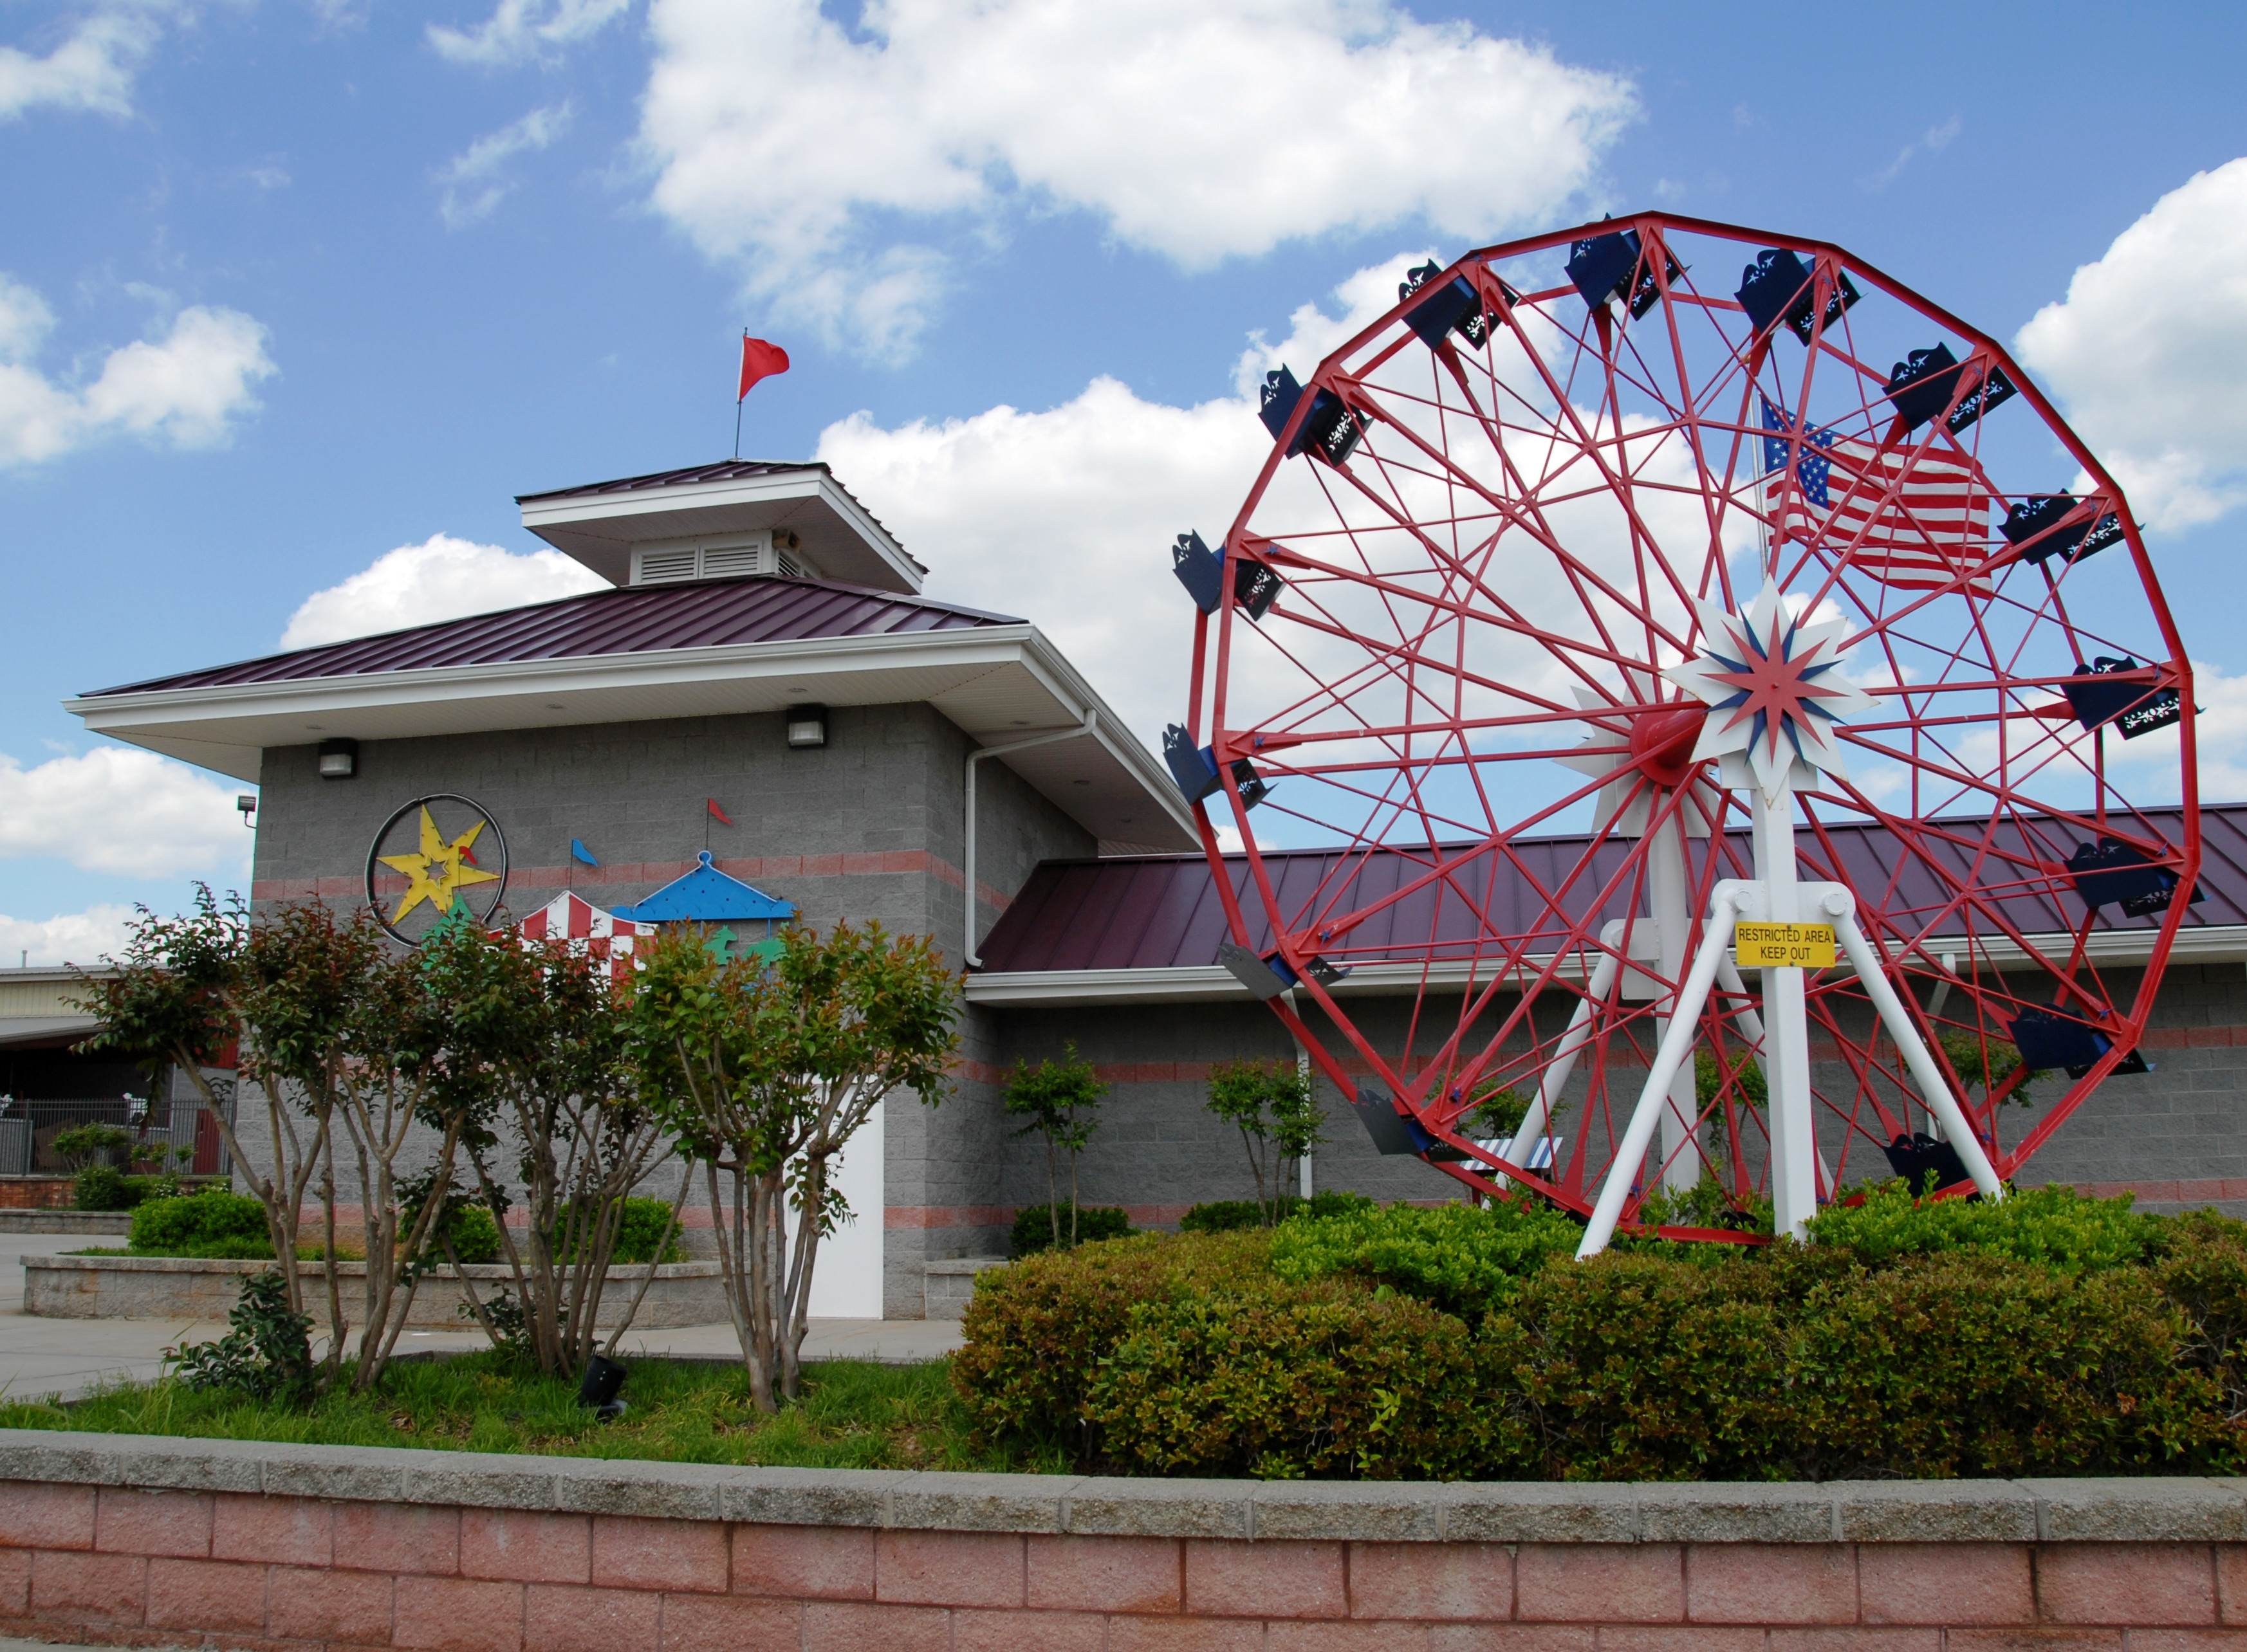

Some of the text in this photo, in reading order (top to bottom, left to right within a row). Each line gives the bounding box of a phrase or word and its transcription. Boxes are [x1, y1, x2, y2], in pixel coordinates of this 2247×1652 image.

[1739, 928, 1831, 943] RESTRICTED AREA
[1761, 946, 1810, 960] KEEP OUT
